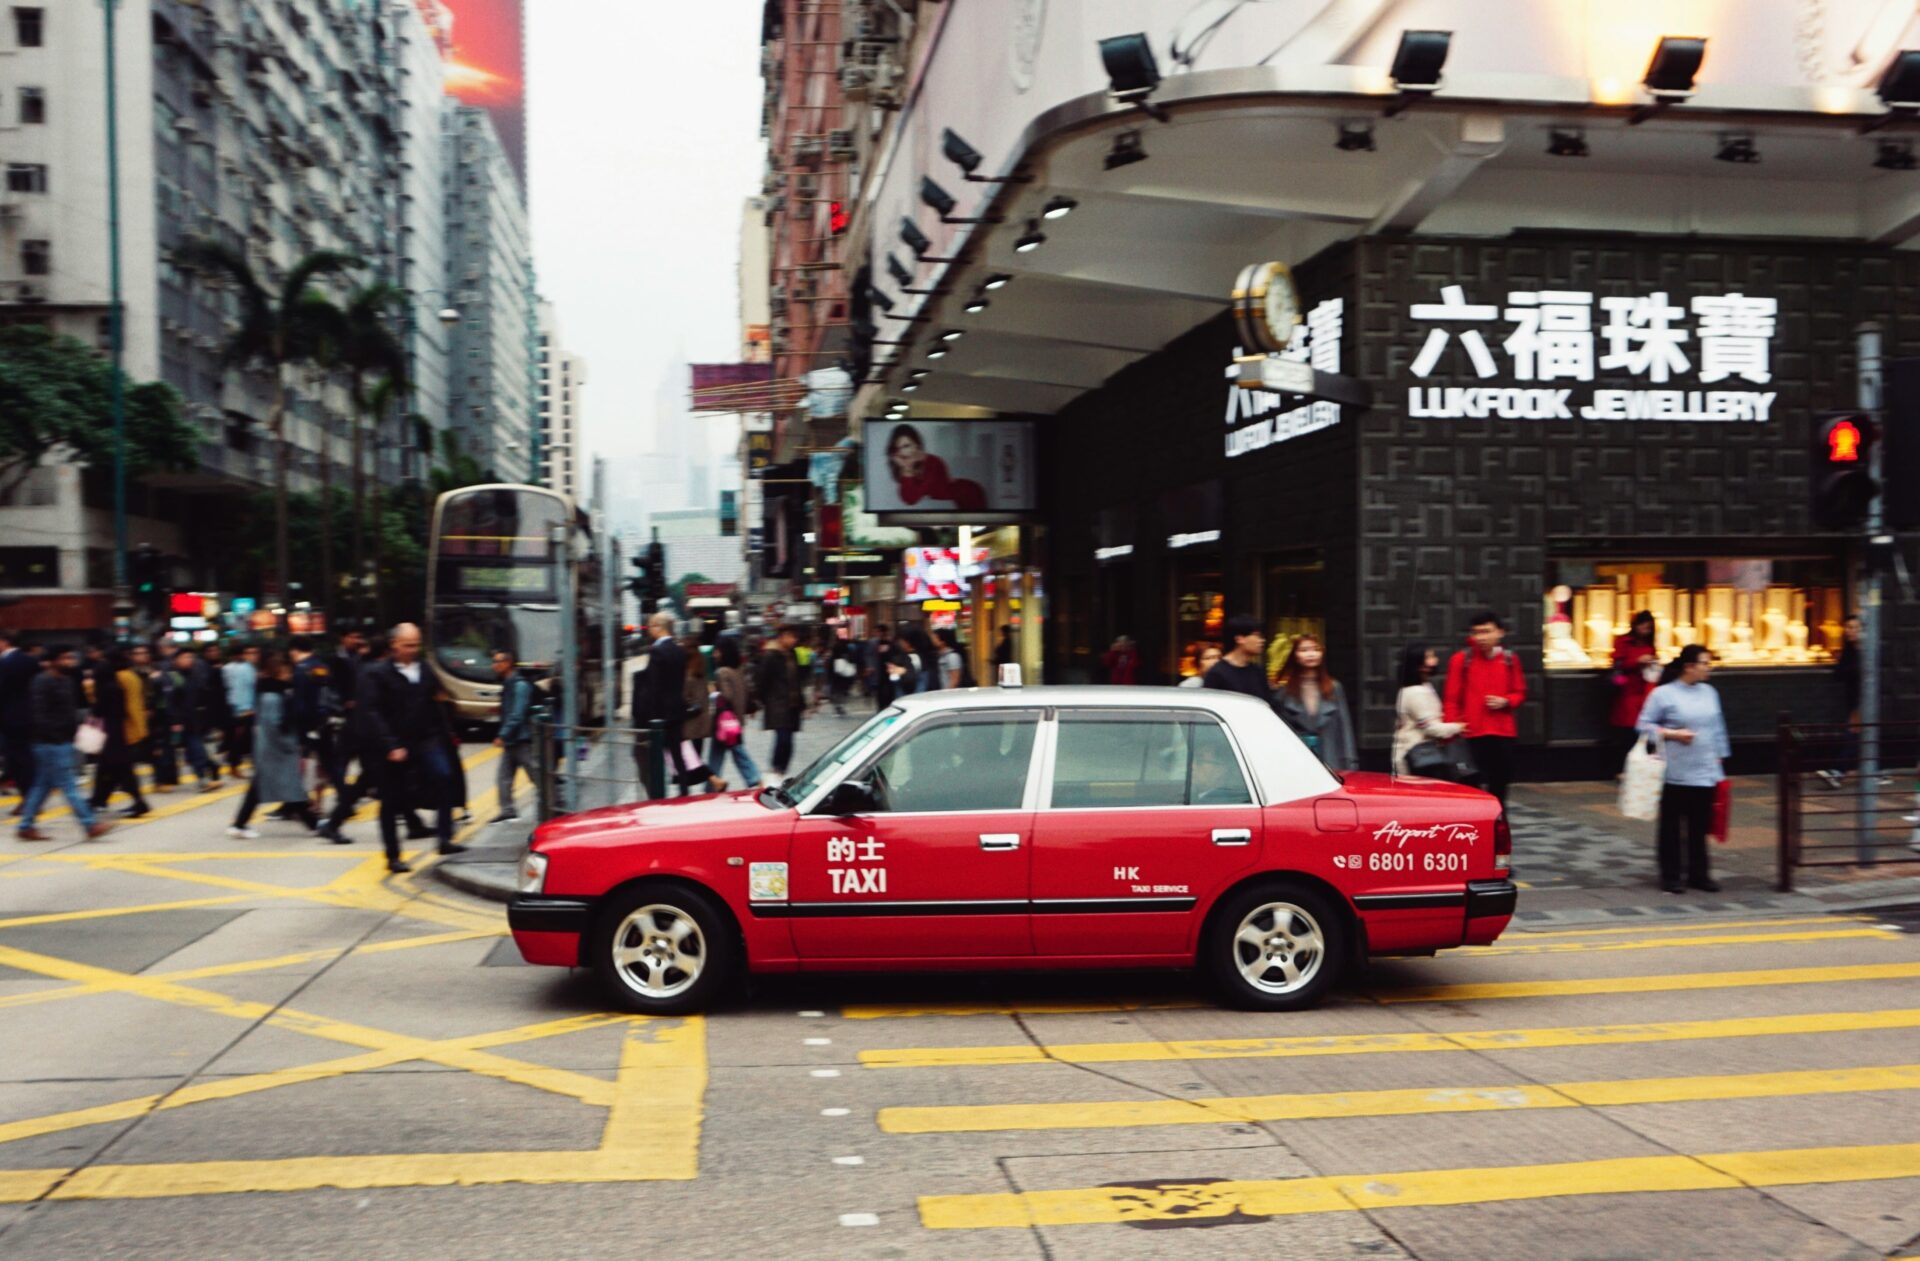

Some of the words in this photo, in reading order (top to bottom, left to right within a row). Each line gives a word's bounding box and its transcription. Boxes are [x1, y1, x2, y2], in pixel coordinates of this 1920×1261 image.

[1409, 284, 1778, 384] 六福珠寶
[1408, 387, 1573, 419] LUKFOOK
[1580, 389, 1777, 421] JEWELLERY
[1372, 820, 1440, 848] Airport
[1442, 823, 1479, 846] Taxi
[826, 836, 886, 863] 的士
[1369, 852, 1414, 871] 6801
[1423, 852, 1468, 871] 6301
[826, 868, 887, 894] TAXI
[1113, 866, 1140, 880] HK
[1130, 885, 1151, 893] TAXI
[1152, 885, 1189, 893] SERVICE
